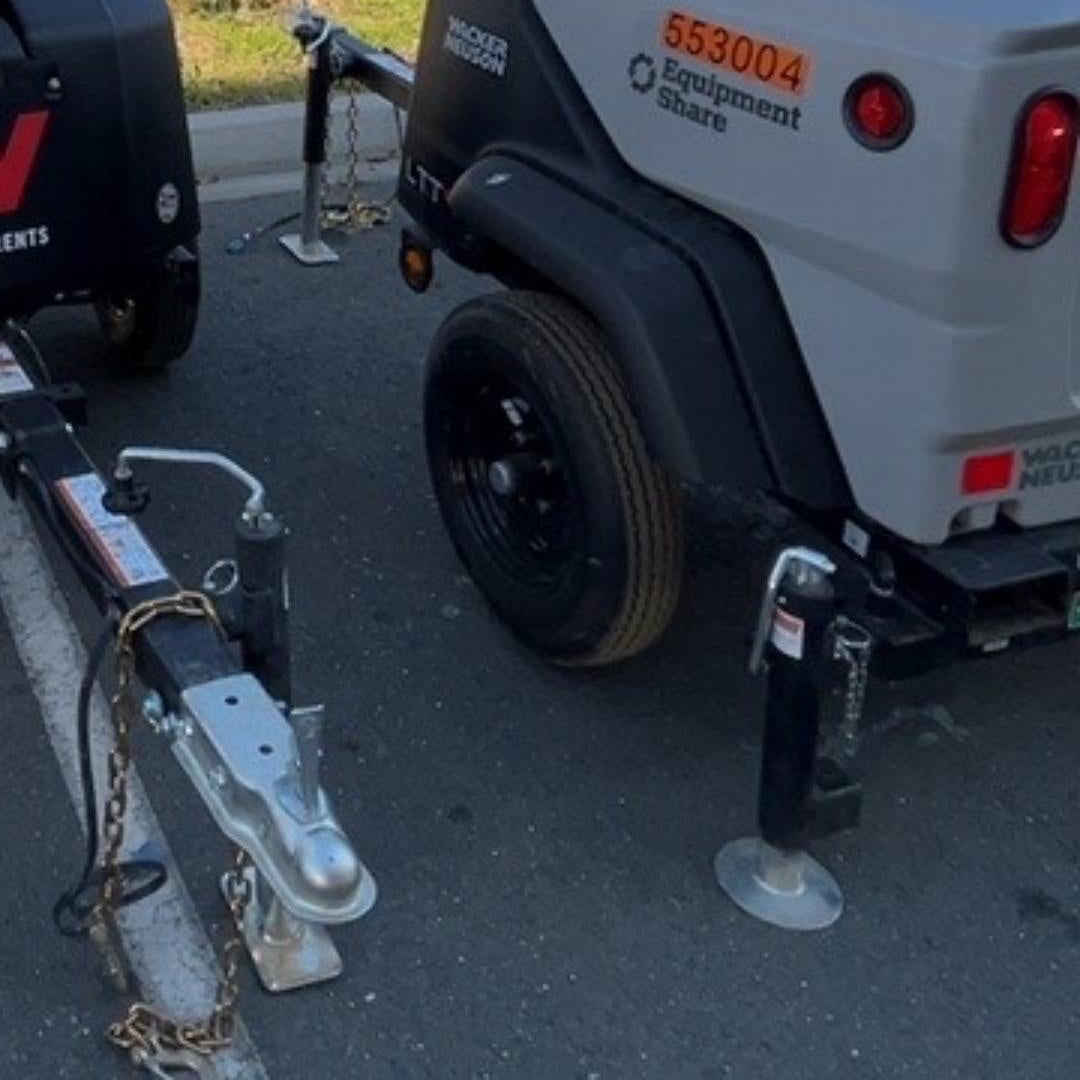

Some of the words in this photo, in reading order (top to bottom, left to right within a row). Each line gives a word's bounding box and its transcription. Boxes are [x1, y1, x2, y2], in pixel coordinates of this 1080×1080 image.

[664, 11, 805, 92] 553004
[656, 84, 728, 133] Share
[661, 56, 803, 132] Equipment
